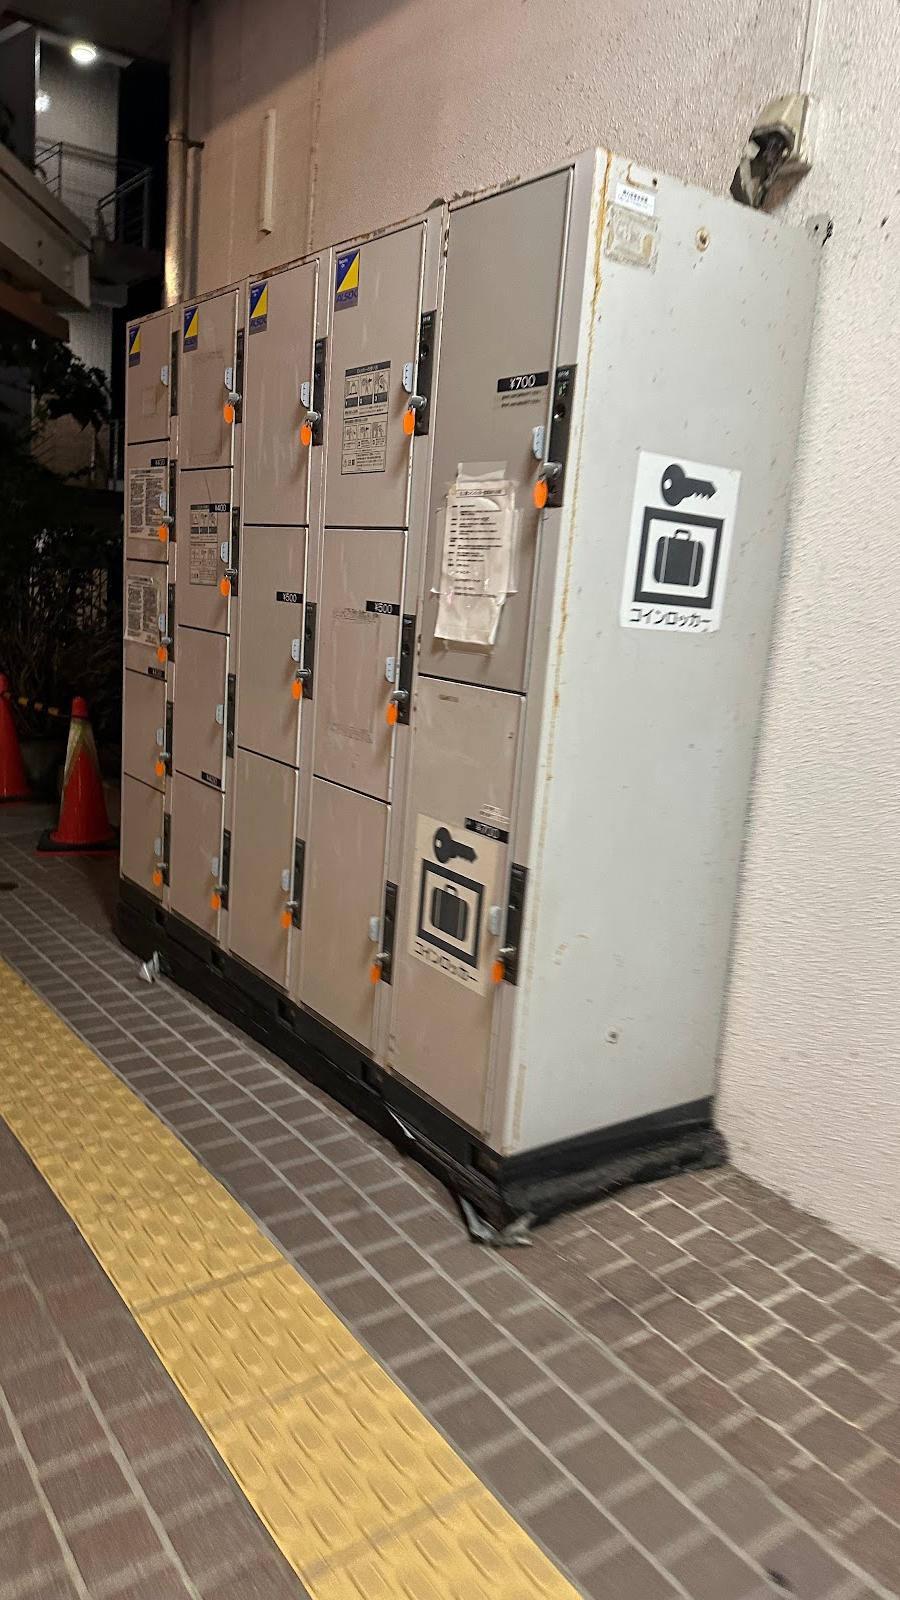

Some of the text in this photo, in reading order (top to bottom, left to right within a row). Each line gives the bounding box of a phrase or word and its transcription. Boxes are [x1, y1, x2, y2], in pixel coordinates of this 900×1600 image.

[509, 374, 536, 389] ¥700
[282, 593, 298, 602] ¥500
[374, 602, 393, 614] ¥500
[629, 608, 712, 628] コインロッカー
